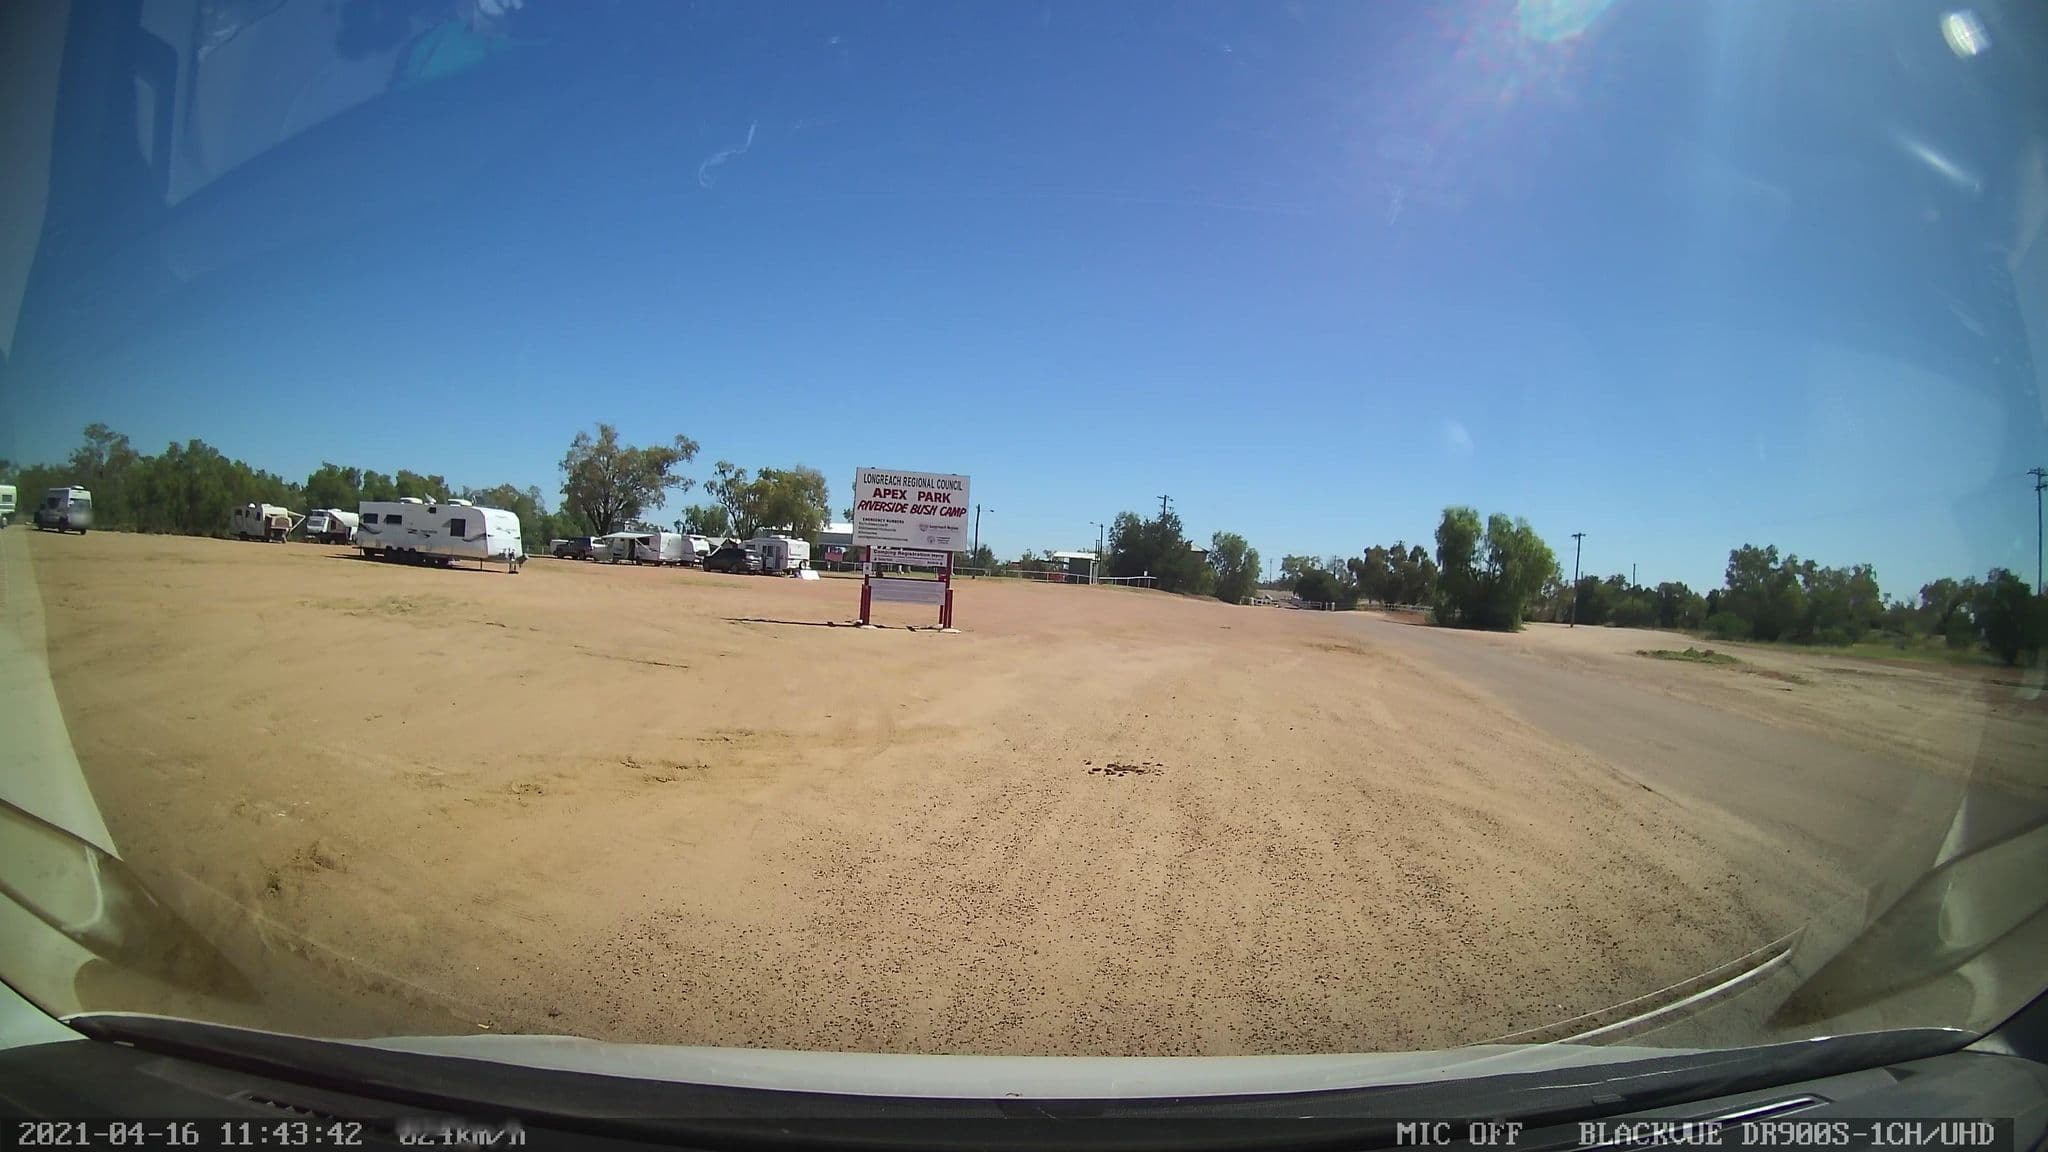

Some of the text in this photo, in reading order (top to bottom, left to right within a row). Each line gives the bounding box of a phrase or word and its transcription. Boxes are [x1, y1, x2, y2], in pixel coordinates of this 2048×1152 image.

[863, 473, 963, 491] LONGREACH REGIONAL COUNCIL
[873, 487, 951, 503] APEX PARK
[857, 499, 967, 518] RIVERSIDE BUSH CAMP
